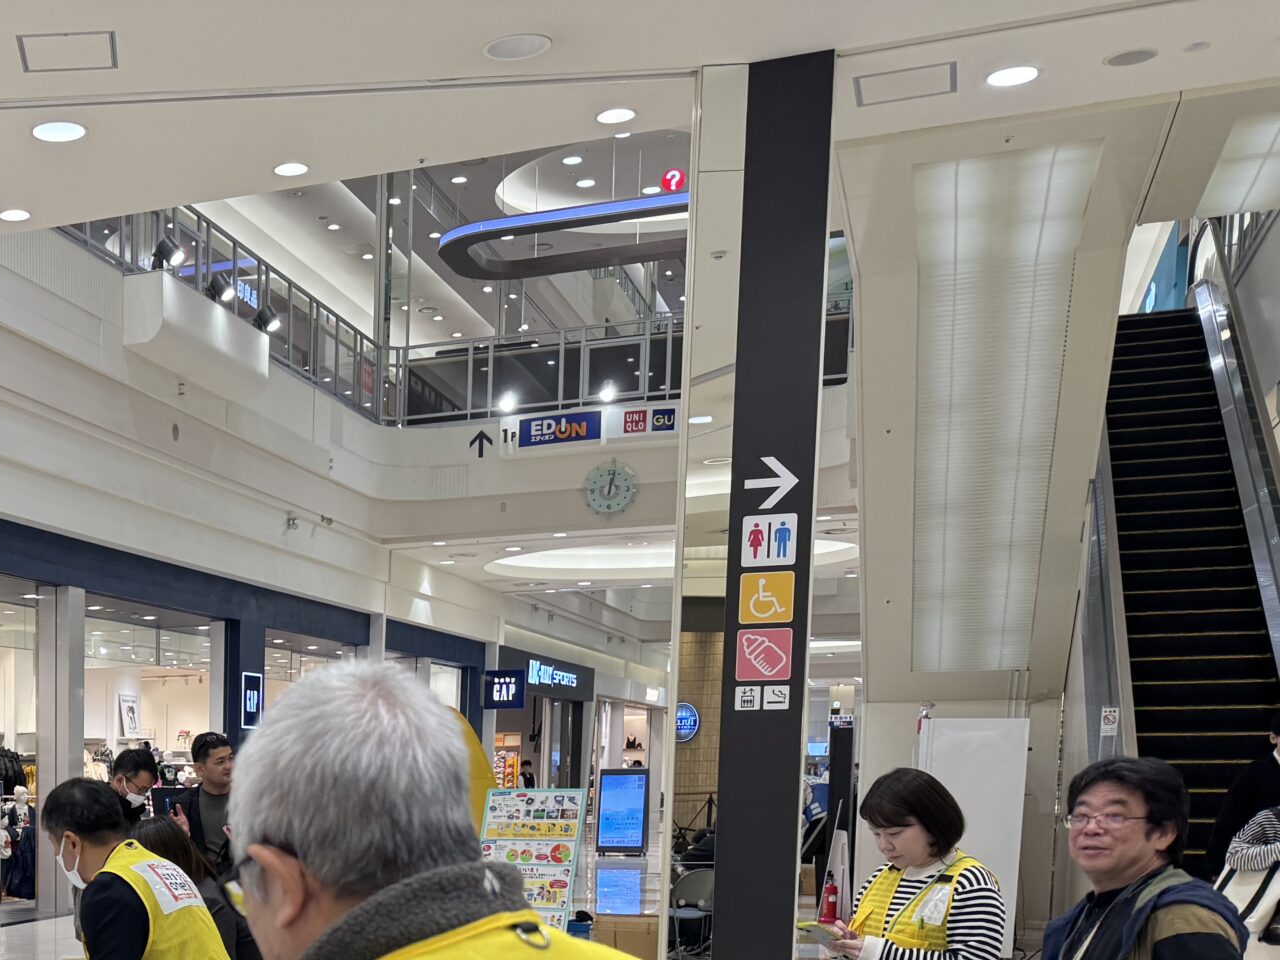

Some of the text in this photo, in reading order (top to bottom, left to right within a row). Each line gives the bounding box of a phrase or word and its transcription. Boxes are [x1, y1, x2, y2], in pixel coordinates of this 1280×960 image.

[626, 414, 644, 422] UNI
[653, 413, 675, 426] GU
[530, 417, 587, 439] EDION
[626, 422, 644, 431] QLO
[502, 428, 517, 444] 1F
[553, 672, 577, 687] SPORTS
[493, 684, 516, 701] GAP
